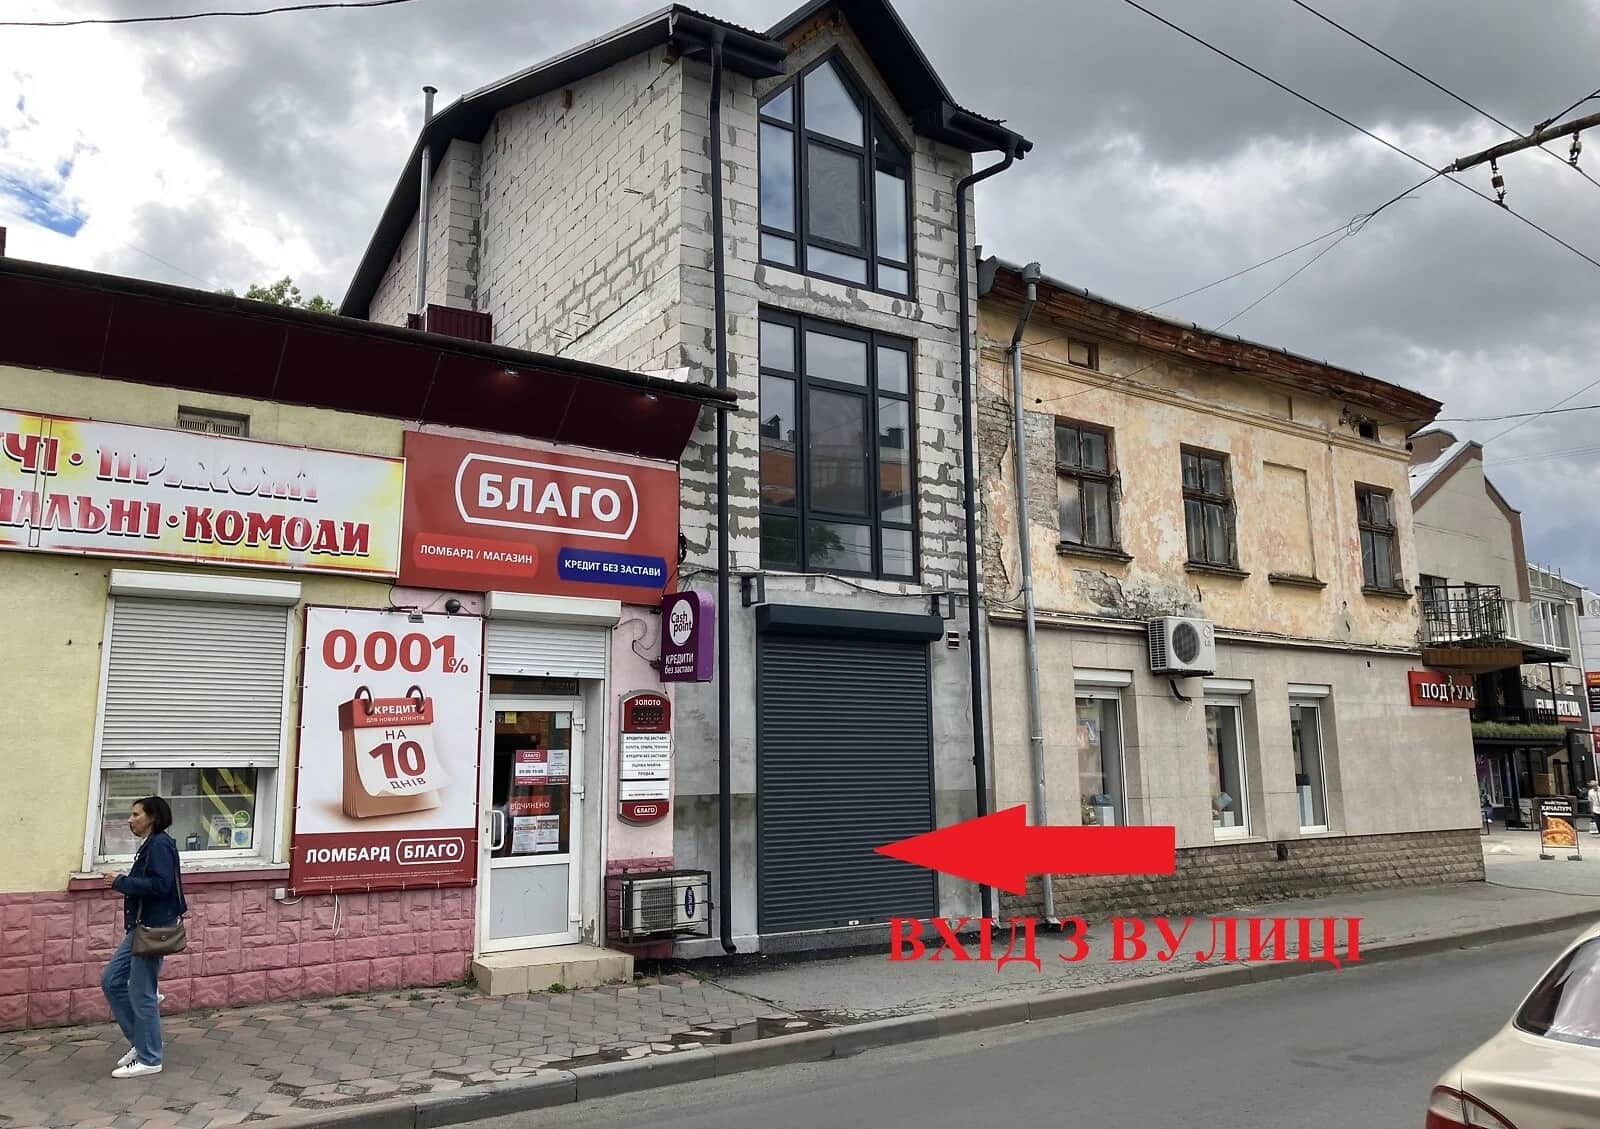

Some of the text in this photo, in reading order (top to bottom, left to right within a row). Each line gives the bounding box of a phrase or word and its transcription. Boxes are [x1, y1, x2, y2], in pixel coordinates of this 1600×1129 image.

[0, 432, 60, 476] ЧІ
[477, 472, 621, 523] БЛАГО
[183, 505, 371, 557] КОМОДИ
[420, 544, 474, 560] ЛОМБАРД
[483, 546, 533, 564] МАГАЗИН
[564, 559, 661, 577] КРЕДИТ БЕЗ ЗАСТАВИ
[671, 611, 688, 624] Cash
[673, 621, 693, 637] point
[665, 652, 694, 665] КРЕДИТИ
[664, 665, 674, 675] без
[374, 704, 417, 714] КРЕДИТ
[385, 729, 407, 740] НА
[368, 740, 426, 779] 10
[390, 777, 427, 789] ДНІВ
[636, 806, 656, 814] БЛАГО
[305, 842, 458, 863] ЛОМБАРД БЛАГО
